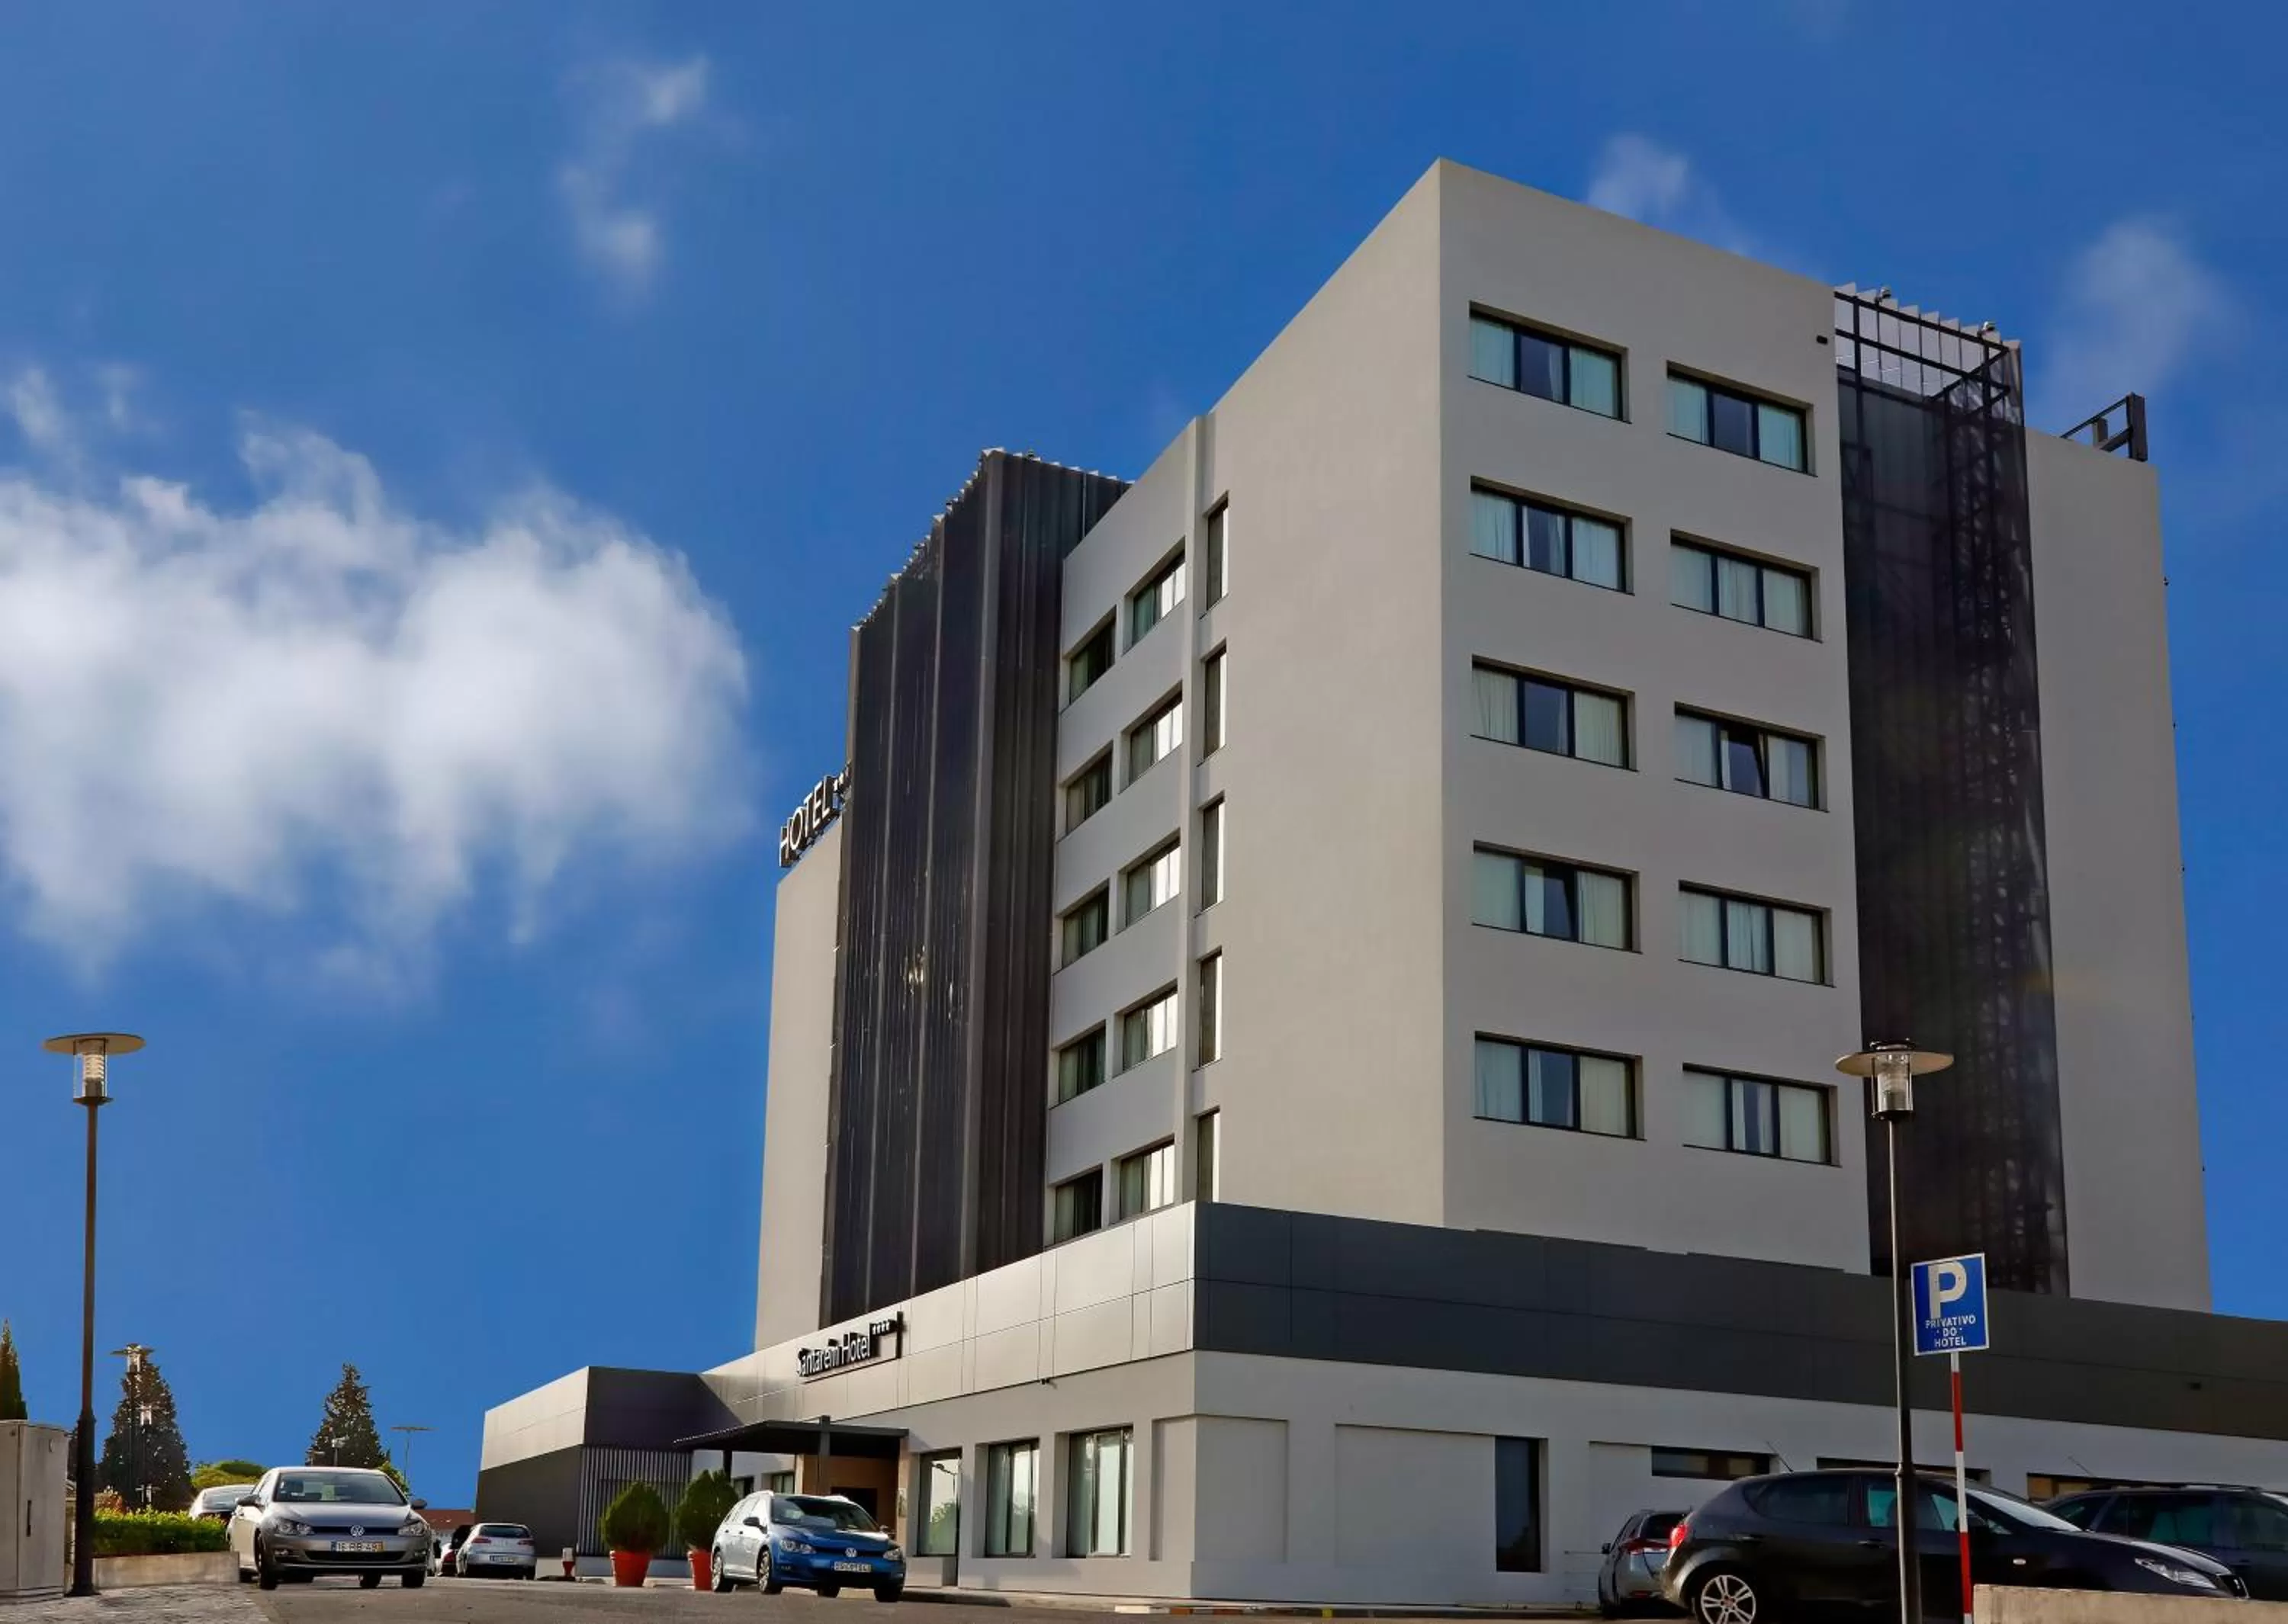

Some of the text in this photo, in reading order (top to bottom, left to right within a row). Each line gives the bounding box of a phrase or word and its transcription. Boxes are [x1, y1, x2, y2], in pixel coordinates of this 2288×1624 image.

[779, 775, 831, 866] HOTEL
[1927, 1262, 1967, 1319] P
[1926, 1314, 1976, 1329] PRIVATIVO
[842, 1332, 870, 1366] Hotel
[1934, 1336, 1967, 1347] HOTEL
